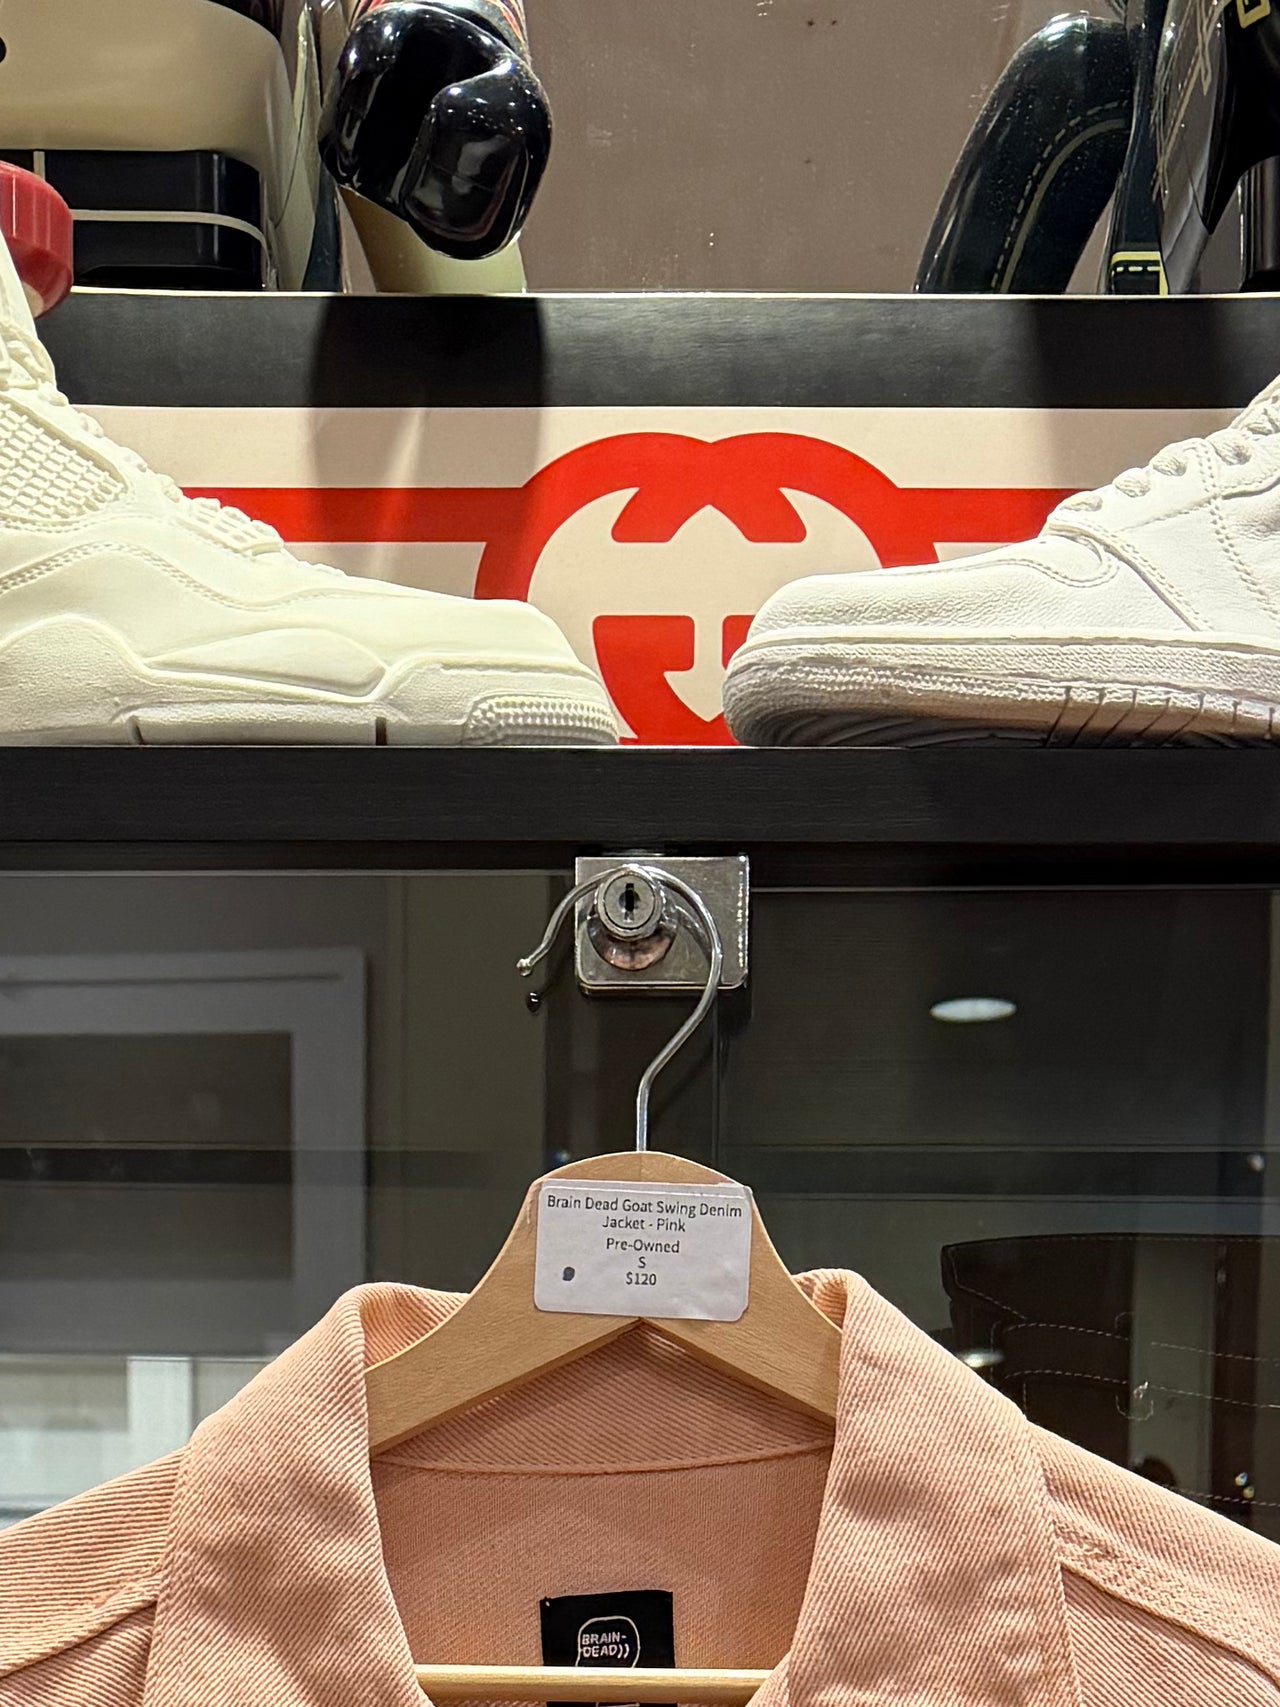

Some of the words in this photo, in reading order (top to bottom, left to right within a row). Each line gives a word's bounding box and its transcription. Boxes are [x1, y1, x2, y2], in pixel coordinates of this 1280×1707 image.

[547, 1194, 581, 1209] Brain
[585, 1196, 618, 1211] Dead
[622, 1198, 653, 1213] Goat
[656, 1200, 697, 1219] Swing
[699, 1202, 742, 1218] Denim
[602, 1214, 645, 1230] Jacket
[656, 1217, 686, 1233] Pink
[606, 1237, 680, 1254] Pre-Owned
[638, 1256, 647, 1269] S
[625, 1272, 657, 1286] $120
